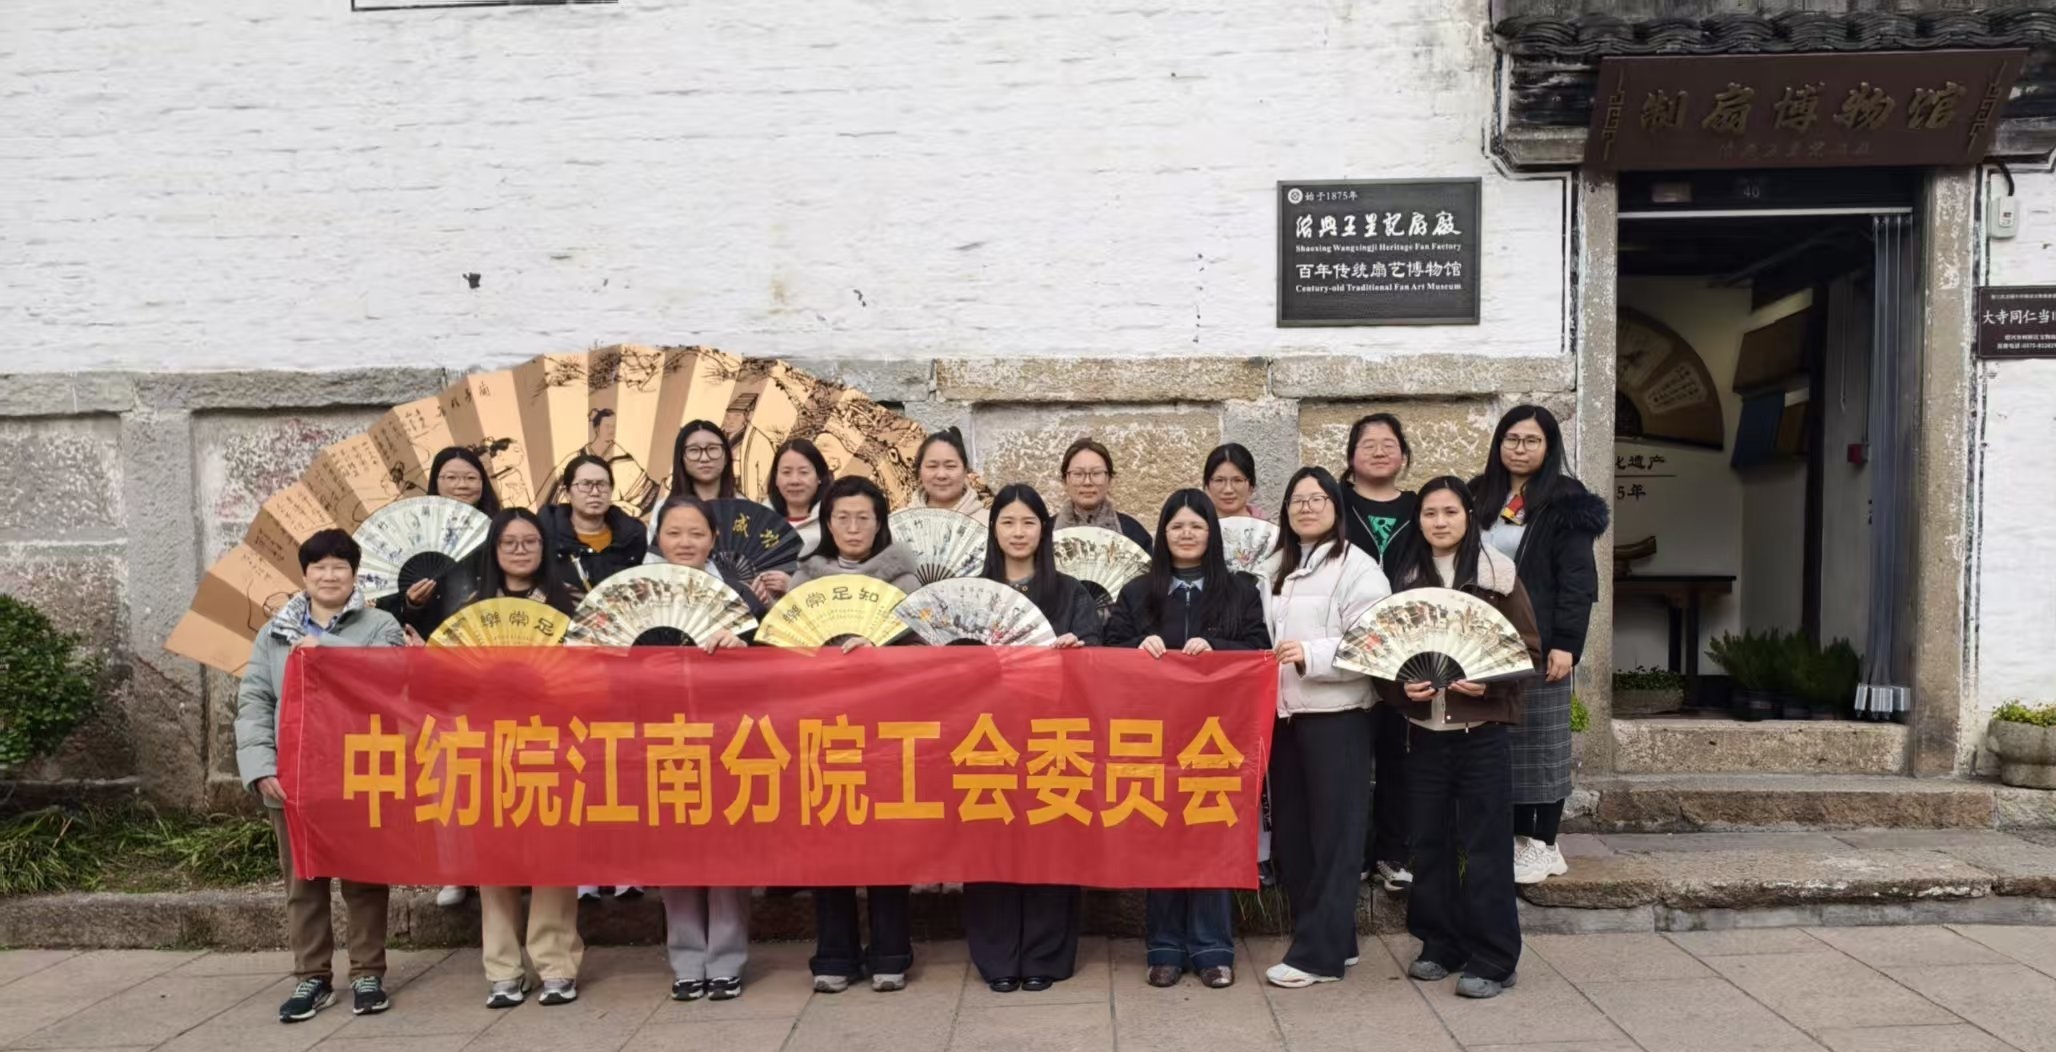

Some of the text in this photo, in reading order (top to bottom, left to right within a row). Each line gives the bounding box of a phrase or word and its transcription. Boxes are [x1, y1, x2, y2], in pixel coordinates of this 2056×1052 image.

[1641, 81, 1966, 134] 制扇博物馆
[1305, 190, 1358, 201] 始于1875年
[1743, 184, 1760, 198] 40
[1295, 242, 1462, 253] Shaoxing Wangxingji Heritage Fan Factory
[1295, 261, 1462, 279] 百年传统扇艺博物馆
[1295, 282, 1462, 293] Century-old Traditional Fan Art Museum
[1983, 308, 2056, 325] 大寺同仁当
[342, 713, 1246, 829] 中纺院江南分院工会委员会
